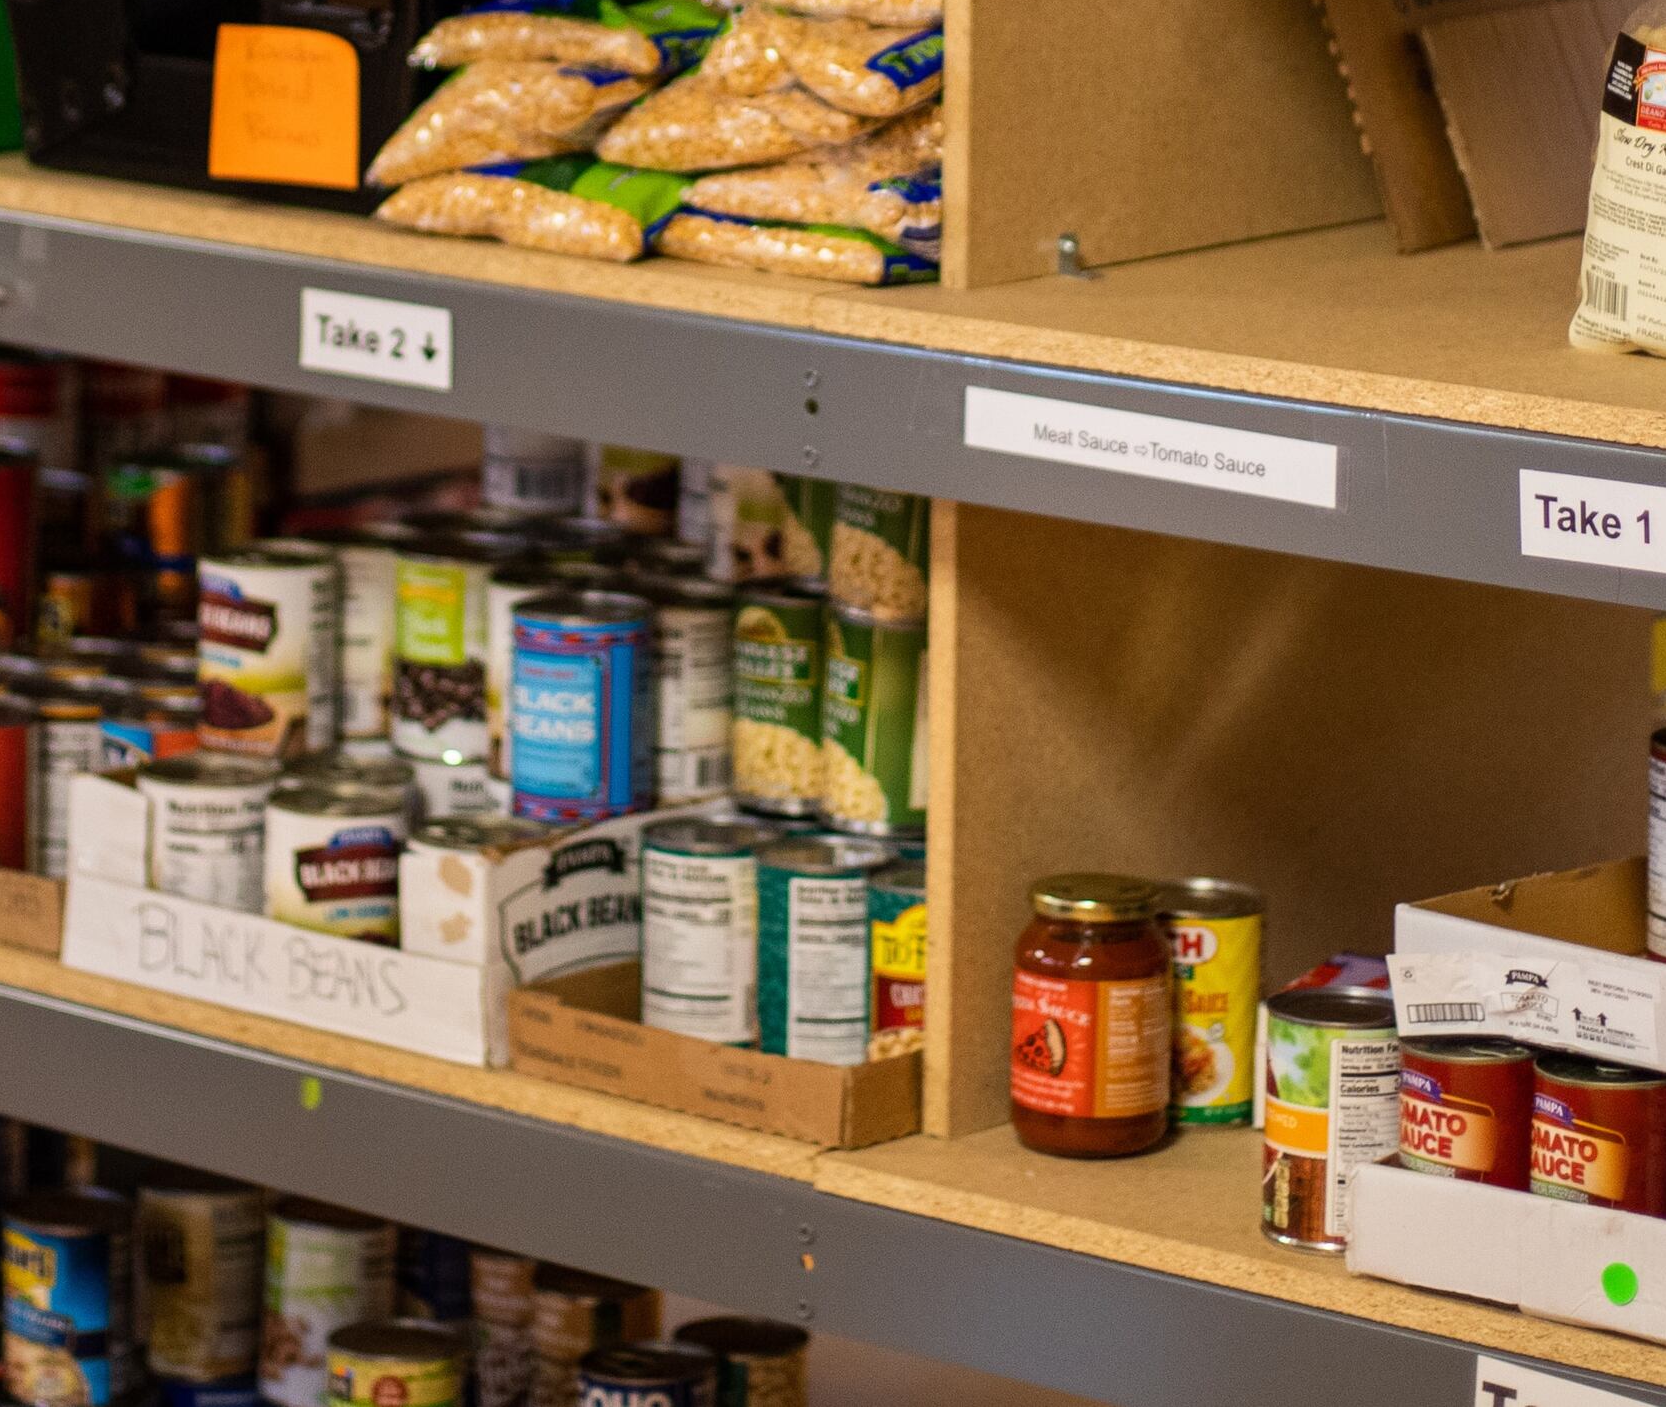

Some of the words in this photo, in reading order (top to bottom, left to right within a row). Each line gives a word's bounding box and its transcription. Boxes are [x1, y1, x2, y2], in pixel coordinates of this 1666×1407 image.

[1635, 136, 1655, 155] Dry
[1626, 156, 1646, 172] Crest
[1649, 161, 1660, 173] Di
[315, 315, 381, 354] Take
[390, 329, 406, 359] 2
[1034, 423, 1075, 448] Meat
[1078, 428, 1129, 456] Sauce
[1149, 440, 1209, 470] Tomato
[1214, 452, 1266, 480] Sauce
[1535, 493, 1622, 540] Take
[1636, 510, 1651, 545] 1
[137, 904, 269, 986] BLACK
[288, 937, 407, 1015] BEANS
[1341, 1044, 1383, 1055] Nutrition
[1340, 1085, 1380, 1094] Calories
[1402, 1072, 1432, 1092] PAMPA
[1400, 1100, 1467, 1137] MATO
[1534, 1097, 1564, 1117] PAMPA
[1400, 1127, 1453, 1159] AUCE
[1533, 1157, 1586, 1186] AUCE
